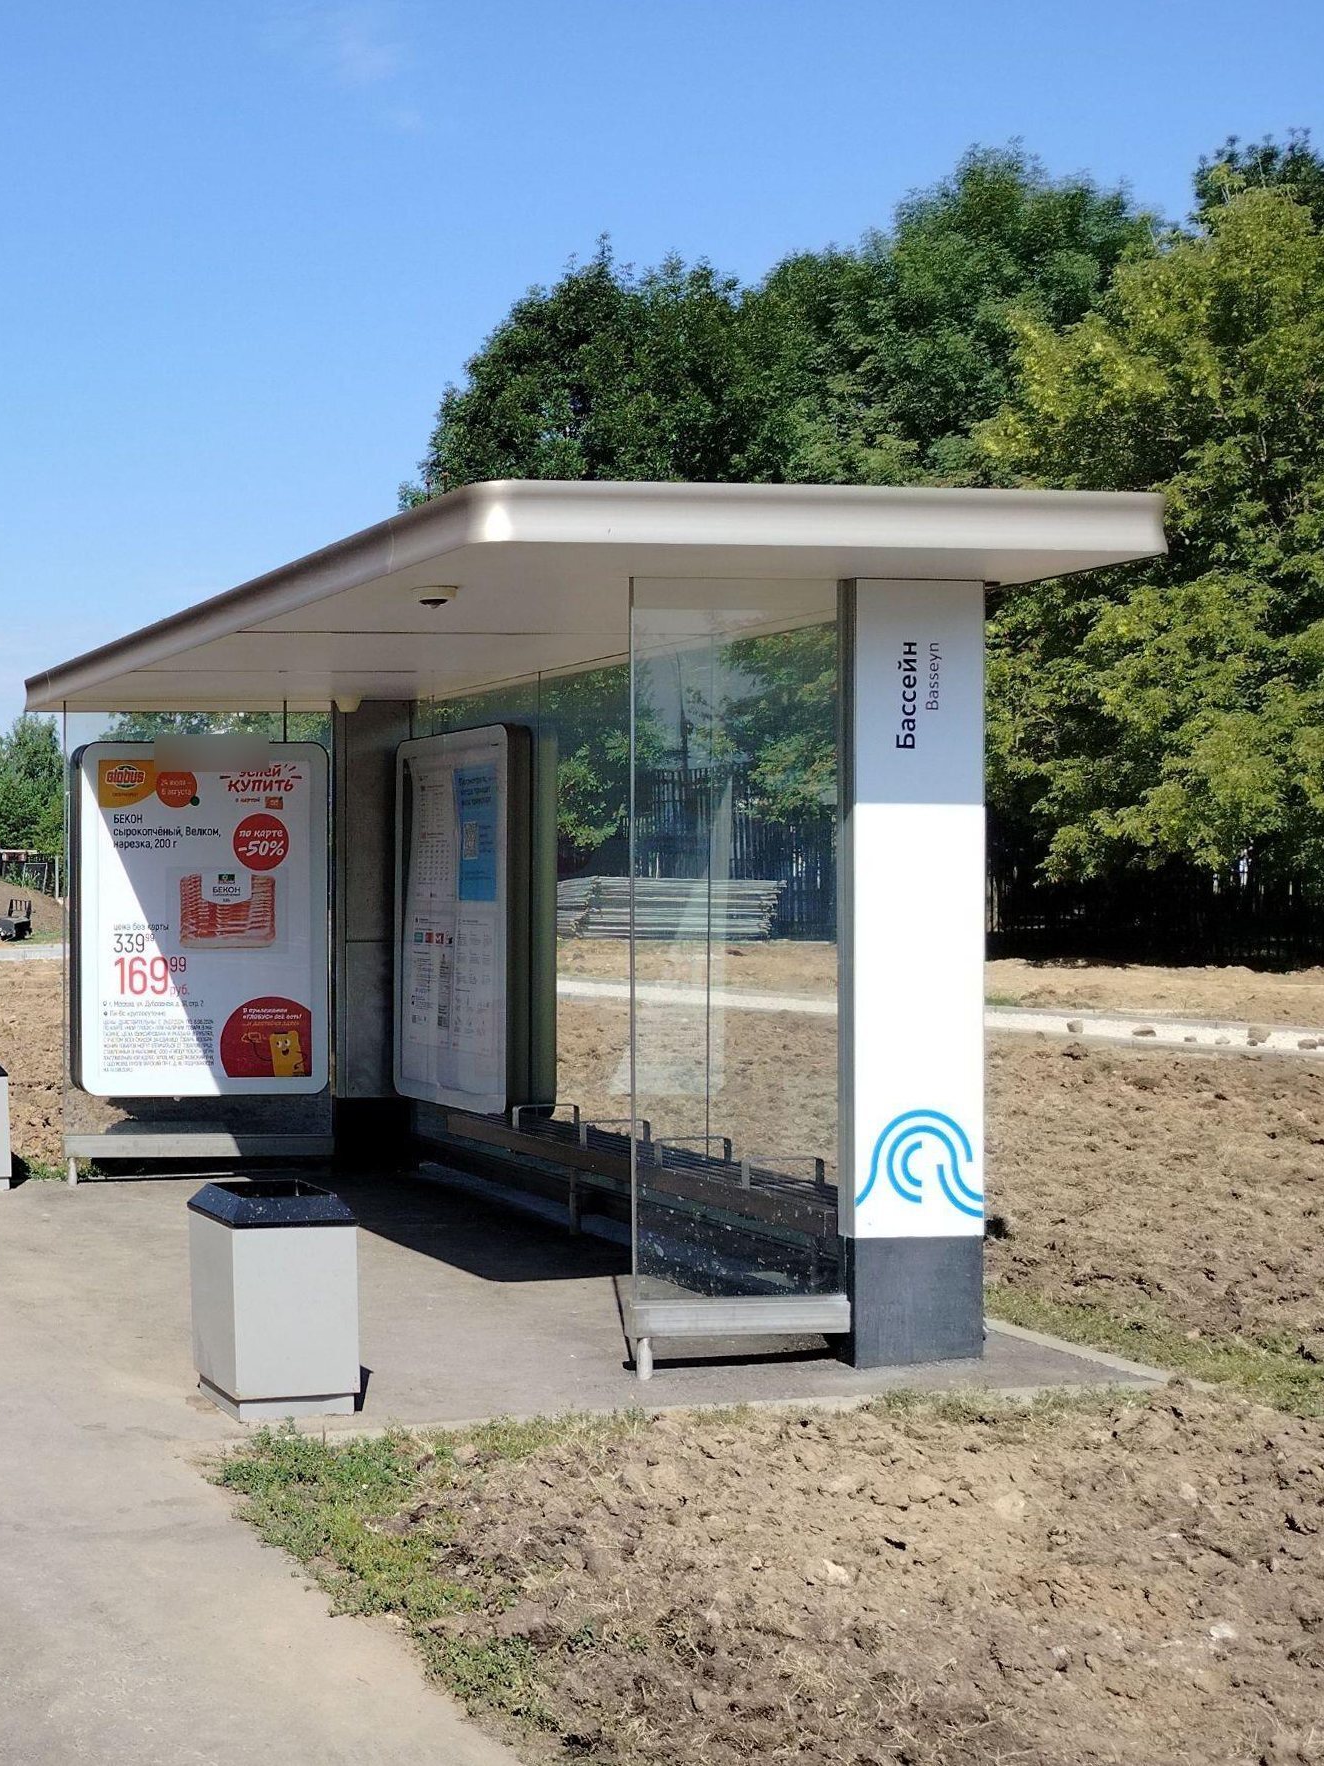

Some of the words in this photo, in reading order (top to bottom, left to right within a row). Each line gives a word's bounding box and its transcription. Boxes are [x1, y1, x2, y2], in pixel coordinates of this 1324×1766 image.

[926, 642, 942, 711] Basseyn
[896, 641, 917, 749] Бассейн
[228, 779, 294, 792] КУПИТЬ
[113, 814, 143, 824] БЕКОН
[113, 826, 184, 837] сырокопчёный,
[185, 826, 222, 837] Велком,
[239, 829, 252, 837] по
[254, 828, 283, 839] карте
[113, 840, 153, 850] нарезка,
[154, 838, 171, 848] 200
[172, 840, 178, 848] г
[238, 840, 285, 857] -50%
[212, 886, 241, 894] БЕКОН
[114, 956, 169, 996] 169
